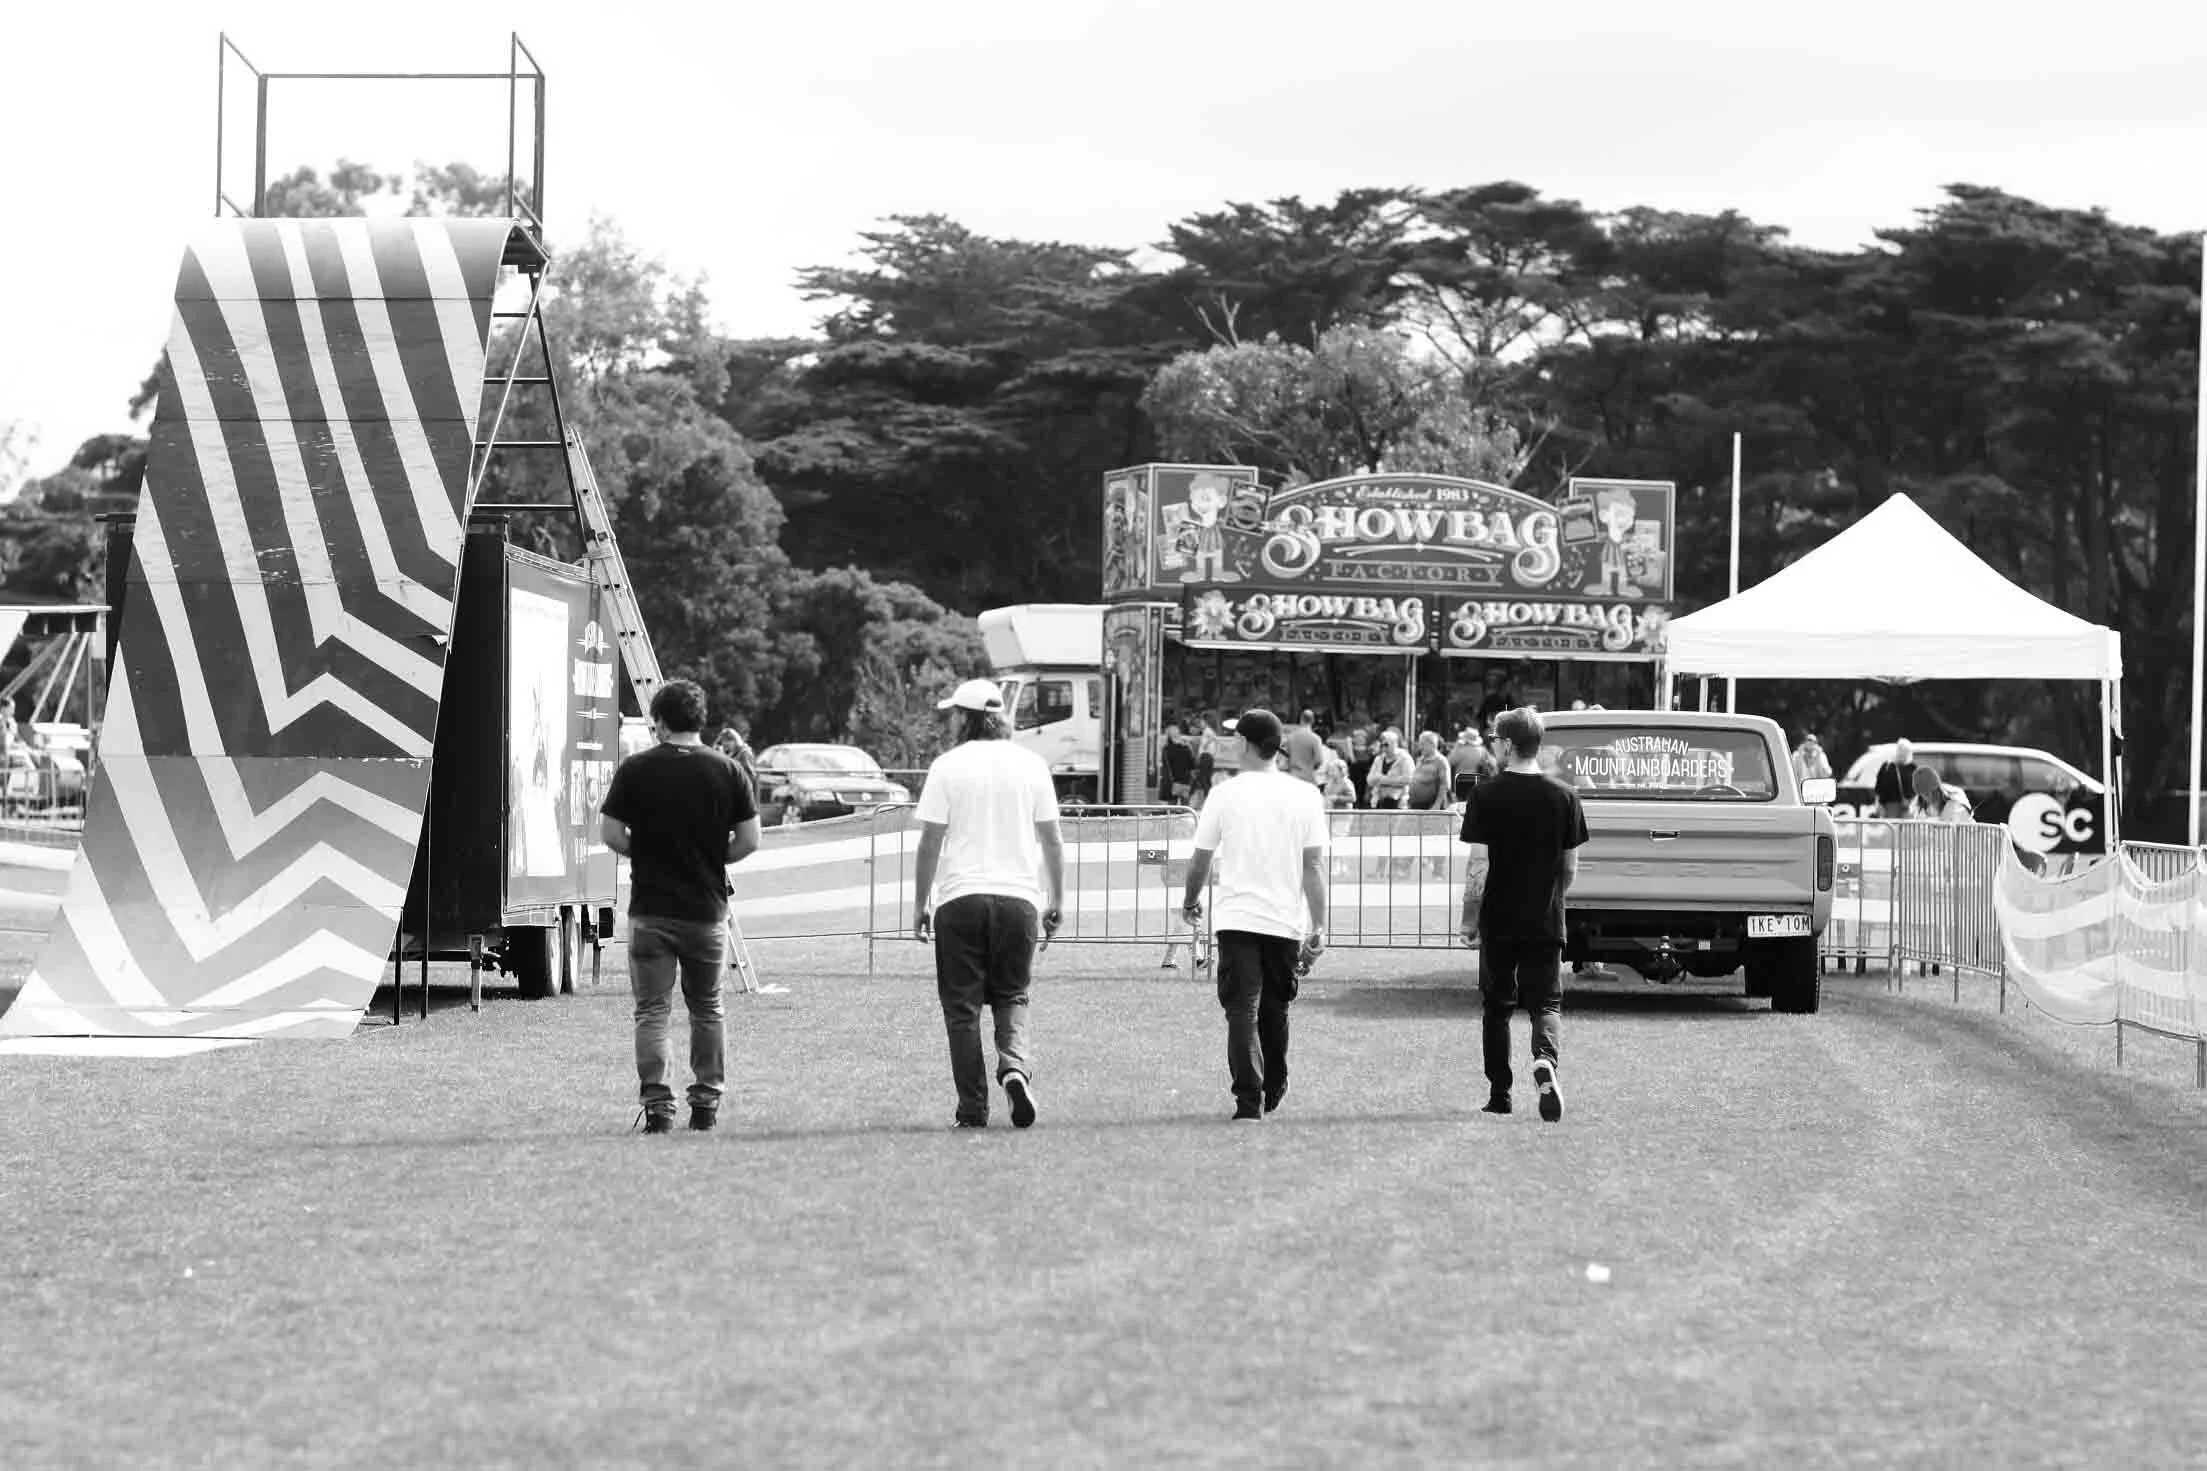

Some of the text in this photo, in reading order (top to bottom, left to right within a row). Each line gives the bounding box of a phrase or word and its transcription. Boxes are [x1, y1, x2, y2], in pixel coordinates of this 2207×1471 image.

[1261, 503, 1560, 587] SHOWBAG
[1330, 561, 1501, 583] FACTORY
[1237, 593, 1424, 645] SHOWBAG
[1449, 601, 1633, 650] SHOWBAG
[1615, 736, 1689, 756] AUSTRALIAN
[1575, 755, 1728, 778] MOUNTAINBOARDERS
